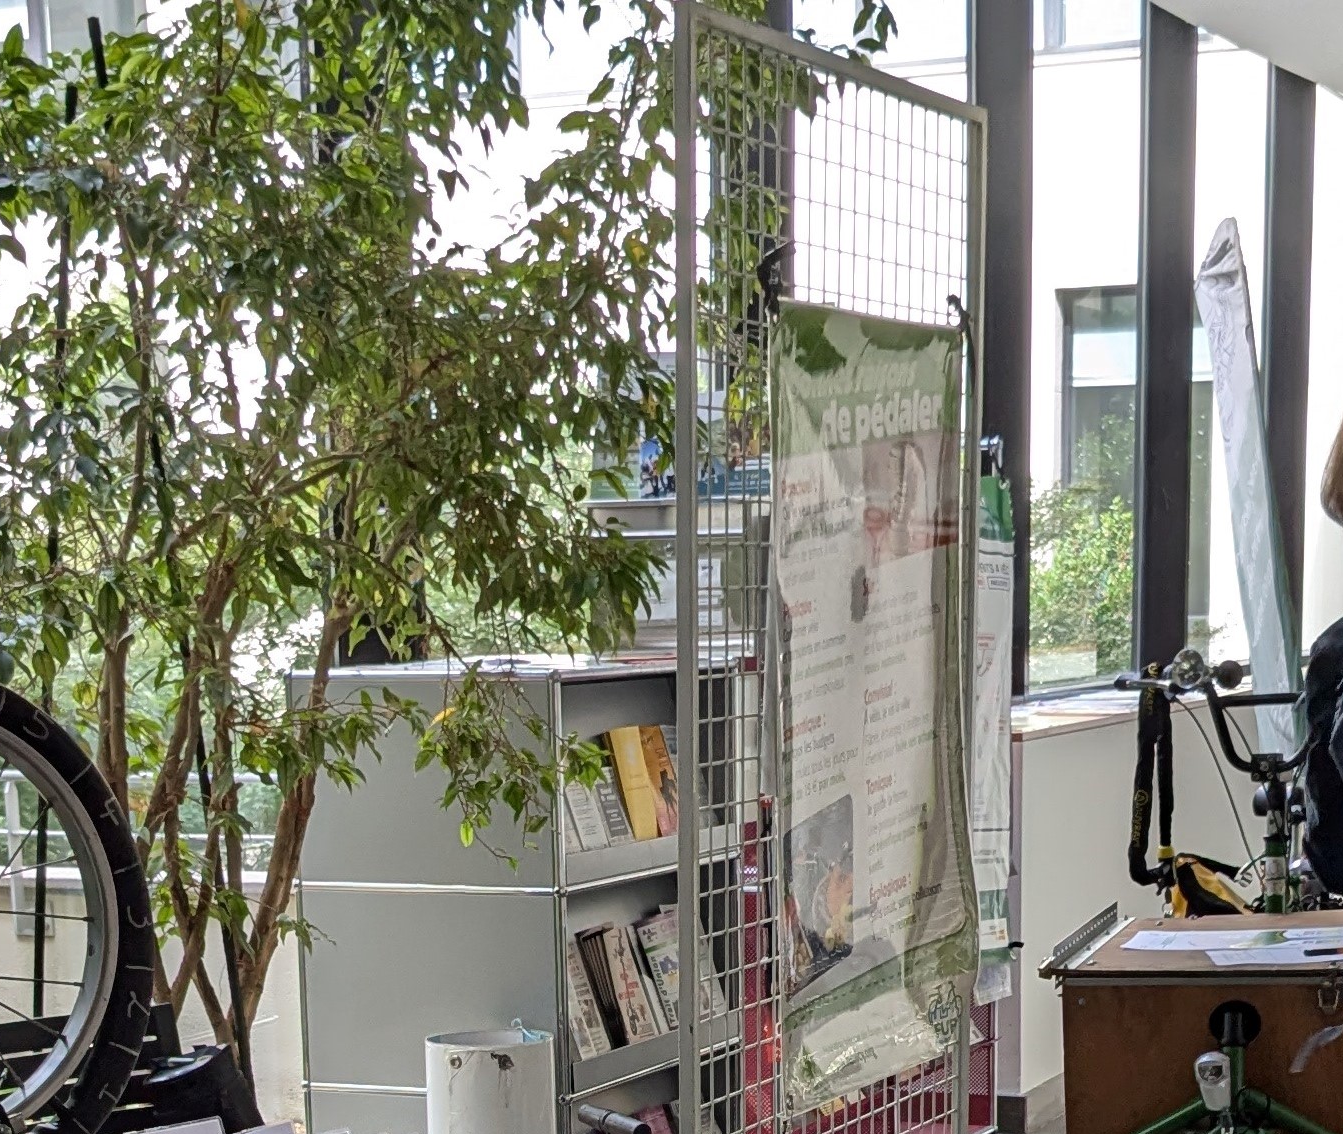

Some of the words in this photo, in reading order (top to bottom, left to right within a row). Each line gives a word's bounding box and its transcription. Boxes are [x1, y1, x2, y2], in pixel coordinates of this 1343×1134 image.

[820, 399, 851, 446] de
[855, 388, 943, 449] pédaler
[23, 708, 50, 742] 5
[126, 904, 153, 930] 3
